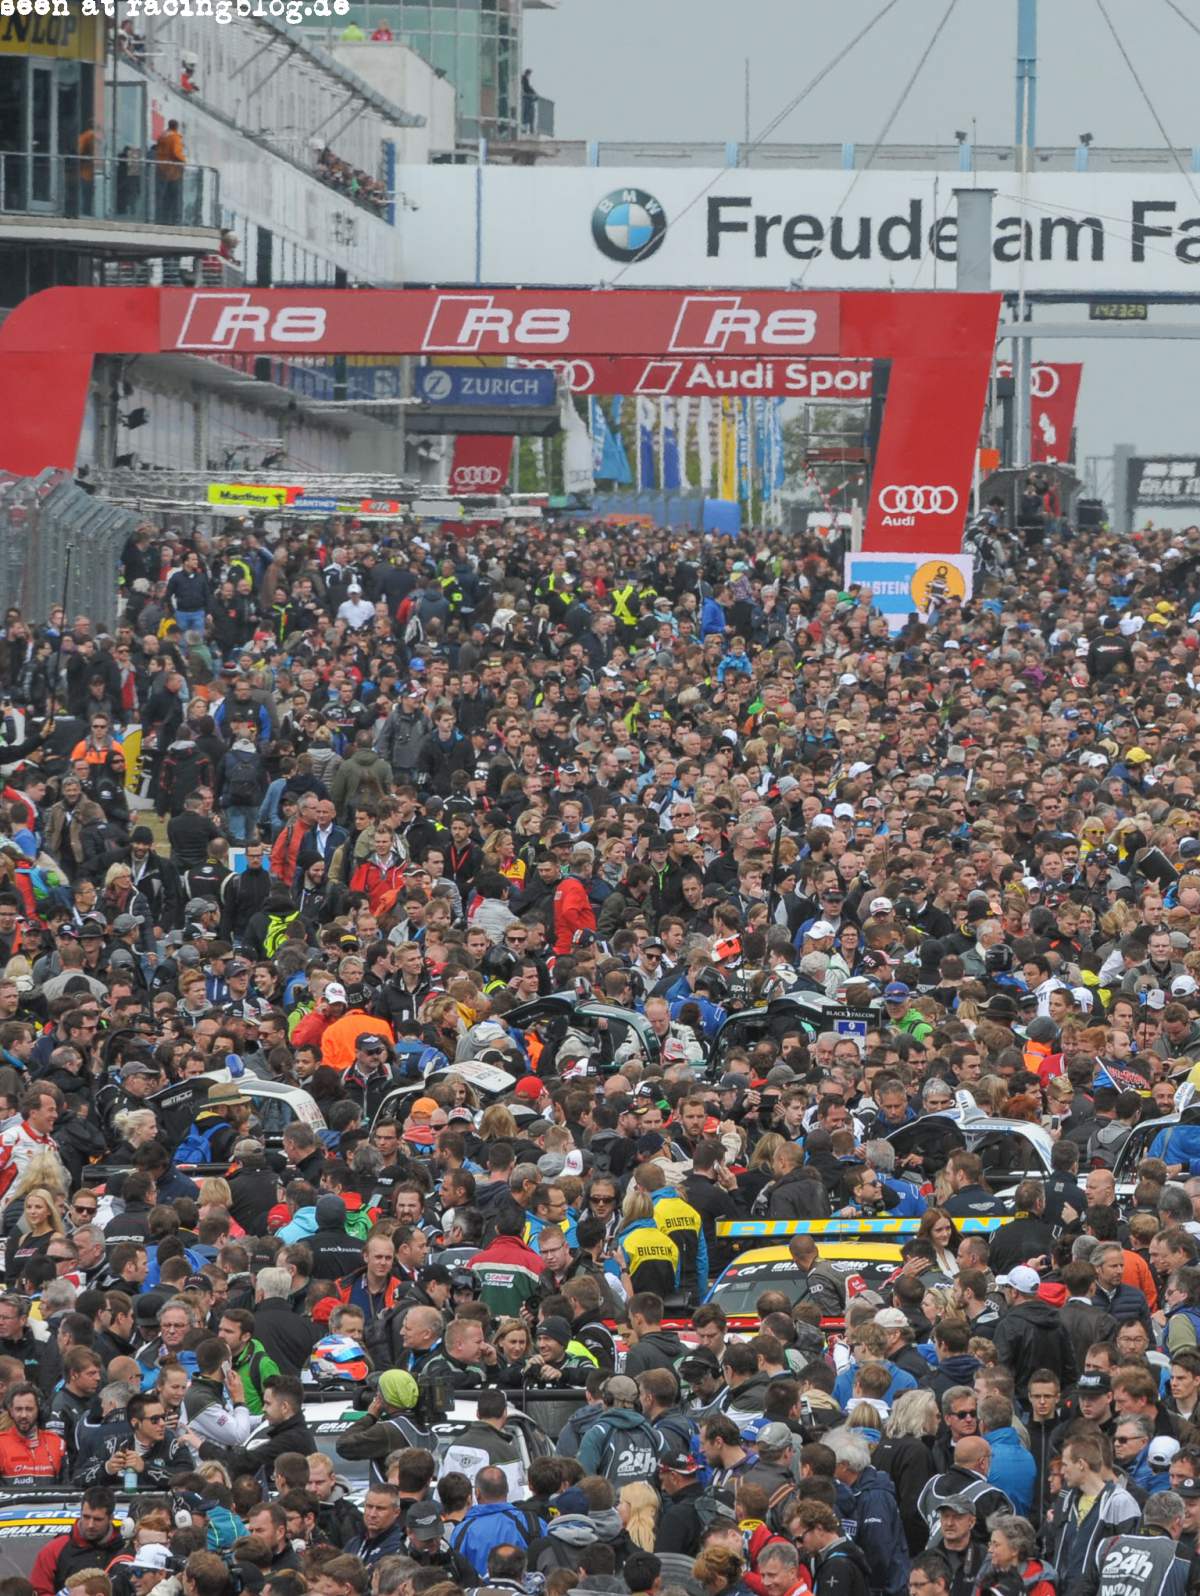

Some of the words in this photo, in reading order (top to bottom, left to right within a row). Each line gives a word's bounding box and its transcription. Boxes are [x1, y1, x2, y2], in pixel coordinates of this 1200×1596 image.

[706, 196, 957, 262] Freude
[992, 216, 1104, 263] am
[211, 306, 327, 342] R8
[456, 308, 570, 344] R8
[703, 309, 817, 345] R8
[461, 377, 539, 396] ZURICH
[686, 363, 774, 389] Audi
[785, 363, 872, 396] Spor
[881, 516, 915, 527] Audi
[666, 1216, 695, 1229] BILSTEIN
[729, 1217, 1004, 1236] BILSTEN
[638, 1246, 673, 1257] BILSTEIN
[1102, 1552, 1153, 1579] 24h
